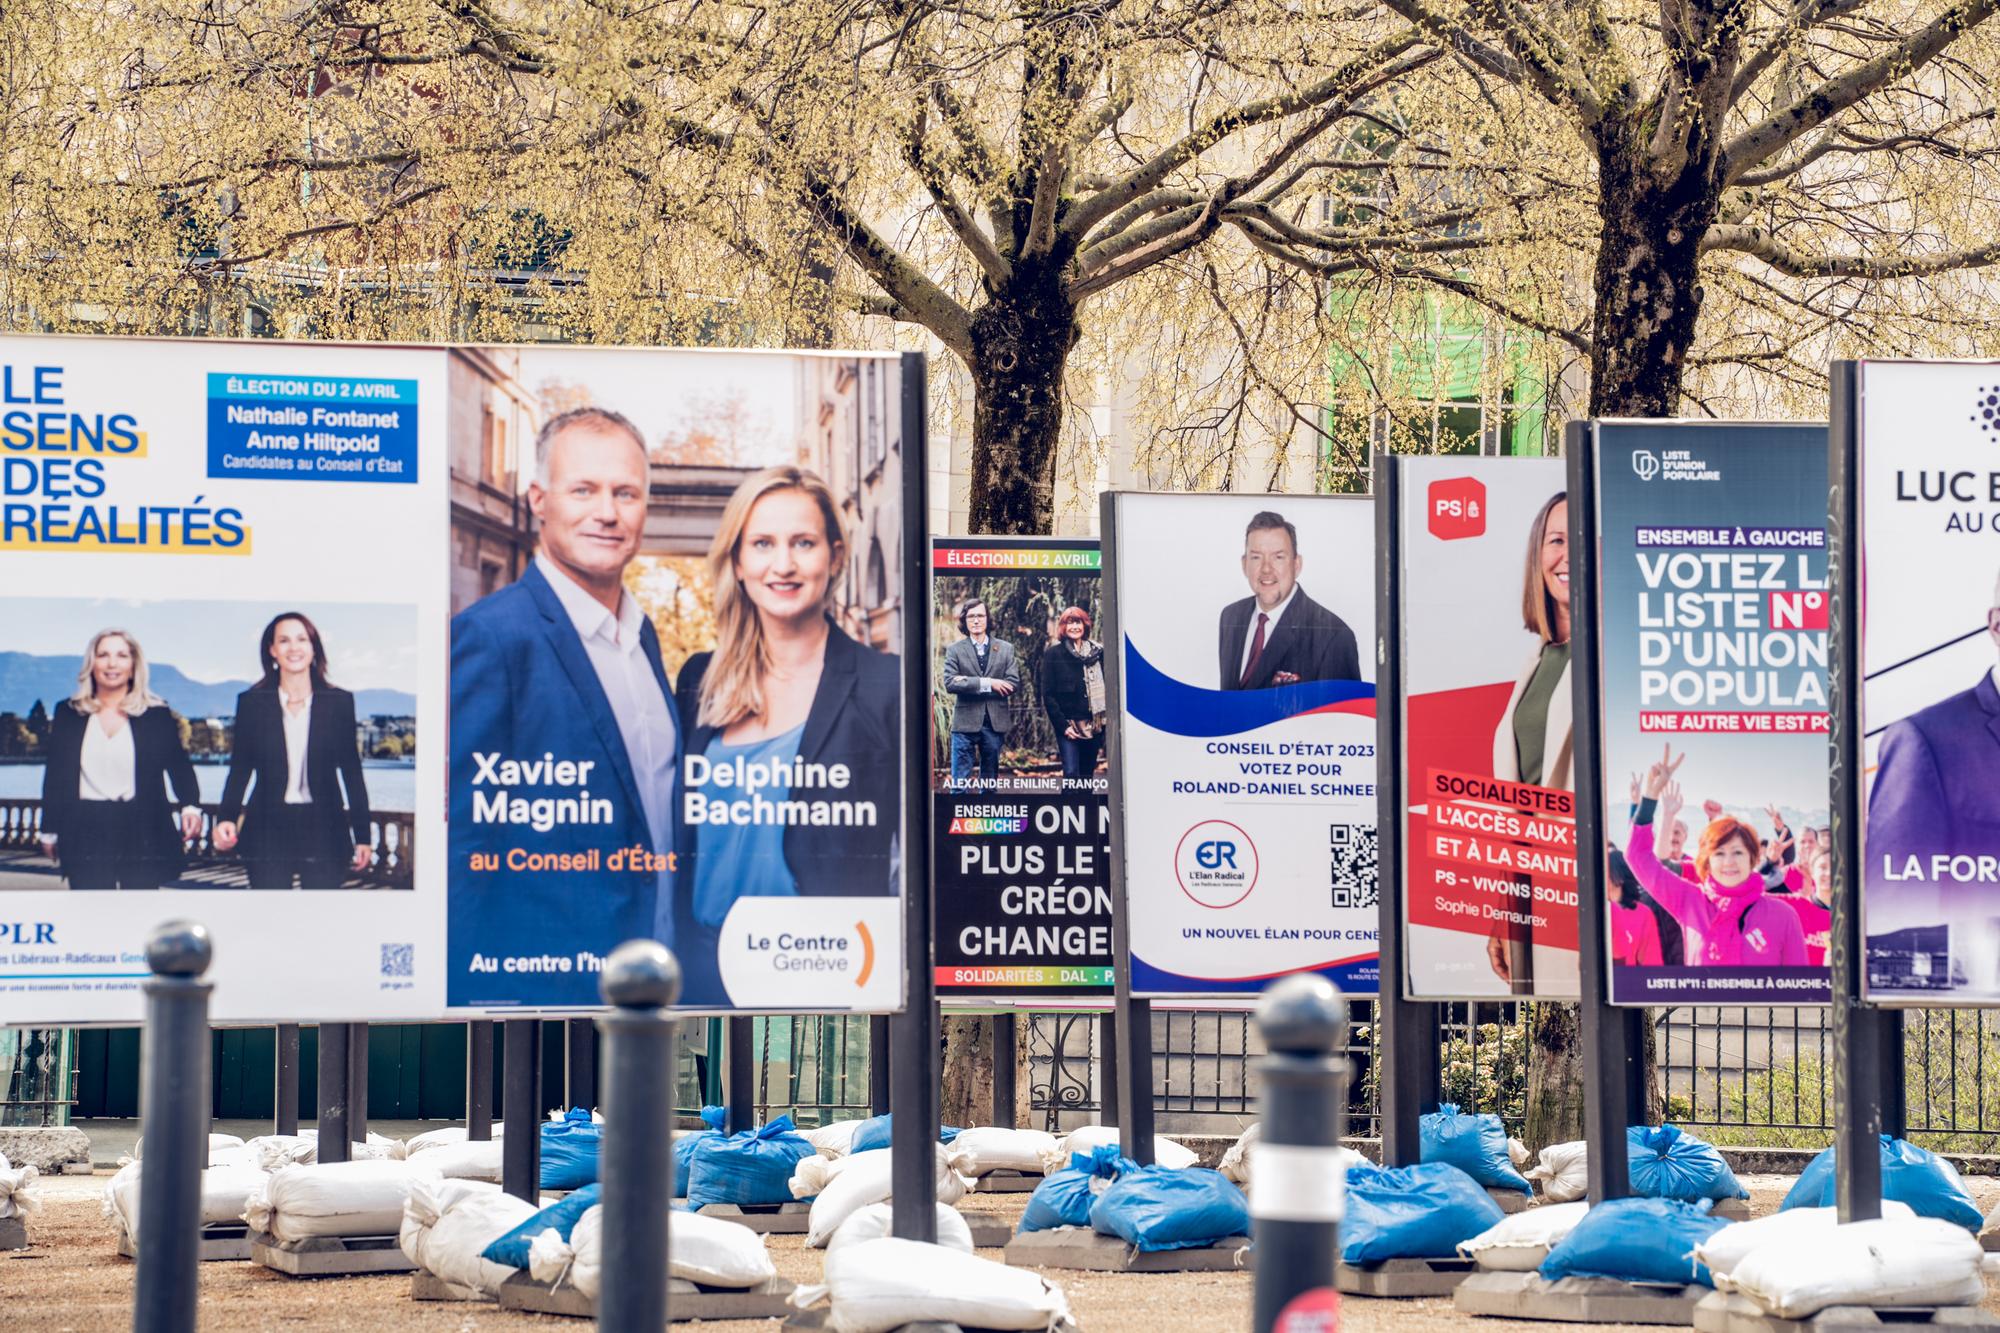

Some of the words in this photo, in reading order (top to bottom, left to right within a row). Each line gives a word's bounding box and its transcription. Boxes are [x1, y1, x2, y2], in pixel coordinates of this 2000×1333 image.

[4, 366, 64, 404] LE
[227, 376, 309, 396] ÉLECTION
[313, 382, 336, 396] DU
[340, 383, 350, 397] 2
[353, 384, 400, 398] AVRIL
[227, 405, 308, 426] Nathalie
[312, 408, 399, 429] Fontanet
[2, 411, 139, 453] SENS
[246, 431, 299, 450] Anne
[304, 433, 380, 456] Hiltpold
[223, 454, 294, 470] Candidates
[297, 459, 313, 470] au
[317, 457, 362, 472] Conseil
[366, 456, 403, 473] d'État
[1663, 451, 1690, 460] LISTE
[1663, 461, 1706, 470] D'UNION
[4, 458, 106, 498] DES
[1663, 471, 1720, 481] POPULAIRE
[1897, 471, 1976, 501] LUC
[1436, 500, 1462, 517] PS
[4, 496, 245, 547] RÉALITÉS
[1946, 512, 1983, 532] AU
[1637, 529, 1730, 545] ENSEMBLE
[1732, 526, 1747, 546] À
[1750, 531, 1824, 546] GAUCHE
[947, 550, 1014, 566] ÉLECTION
[1018, 554, 1038, 566] DU
[1042, 554, 1049, 566] 2
[1053, 554, 1092, 566] AVRIL
[1636, 553, 1786, 589] VOTEZ
[1798, 555, 1829, 589] L
[1638, 592, 1760, 628] LISTE
[1639, 631, 1828, 667] D'UNION
[1640, 670, 1827, 706] POPULA
[1641, 715, 1678, 730] UNE
[1681, 715, 1740, 730] AUTRE
[1743, 716, 1771, 730] VIE
[1775, 716, 1807, 730] EST
[1206, 742, 1274, 756] CONSEIL
[1279, 741, 1334, 756] D'ÉTAT
[1338, 744, 1375, 757] 2023
[472, 752, 595, 787] Xavier
[684, 754, 851, 795] Delphine
[1240, 763, 1292, 775] VOTEZ
[1297, 764, 1342, 776] POUR
[943, 778, 1010, 790] ALEXANDER
[1014, 779, 1060, 791] ENILINE,
[1062, 779, 1109, 792] FRANÇO
[1173, 781, 1306, 795] ROLAND-DANIEL
[1311, 783, 1378, 796] SCHNEE
[1436, 775, 1571, 813] SOCIALISTES
[473, 790, 614, 833] Magnin
[684, 793, 877, 827] Bachmann
[955, 804, 1028, 818] ENSEMBLE
[1035, 805, 1086, 834] ON
[964, 820, 1021, 832] GAUCHE
[1436, 805, 1520, 836] L'ACCÈS
[1525, 822, 1567, 844] AUX
[469, 853, 499, 872] au
[507, 848, 600, 872] Conseil
[607, 844, 677, 873] d'État
[961, 846, 1045, 875] PLUS
[1057, 846, 1094, 875] LE
[1436, 837, 1462, 857] ET
[1466, 838, 1481, 861] À
[1486, 845, 1513, 866] LA
[1214, 871, 1245, 880] Radical
[1883, 854, 1925, 881] LA
[1931, 855, 2000, 882] FOR
[1435, 869, 1456, 886] PS
[1472, 875, 1531, 898] VIVONS
[1435, 896, 1479, 917] Sophie
[1483, 904, 1548, 928] Demaurex
[747, 934, 770, 951] Le
[778, 934, 848, 951] Centre
[959, 926, 1114, 956] CHANGE
[1182, 929, 1202, 939] UN
[1206, 929, 1261, 939] NOUVEL
[1264, 926, 1300, 939] ÉLAN
[1303, 930, 1341, 940] POUR
[12, 953, 116, 965] Libéraux-Radicaux
[470, 953, 498, 972] Au
[503, 956, 572, 972] centre
[773, 953, 848, 971] Genève
[955, 967, 1043, 982] SOLIDARITÉS
[1061, 970, 1088, 982] DAL
[1647, 979, 1676, 988] LISTE
[1707, 979, 1764, 989] ENSEMBLE
[1766, 976, 1774, 989] À
